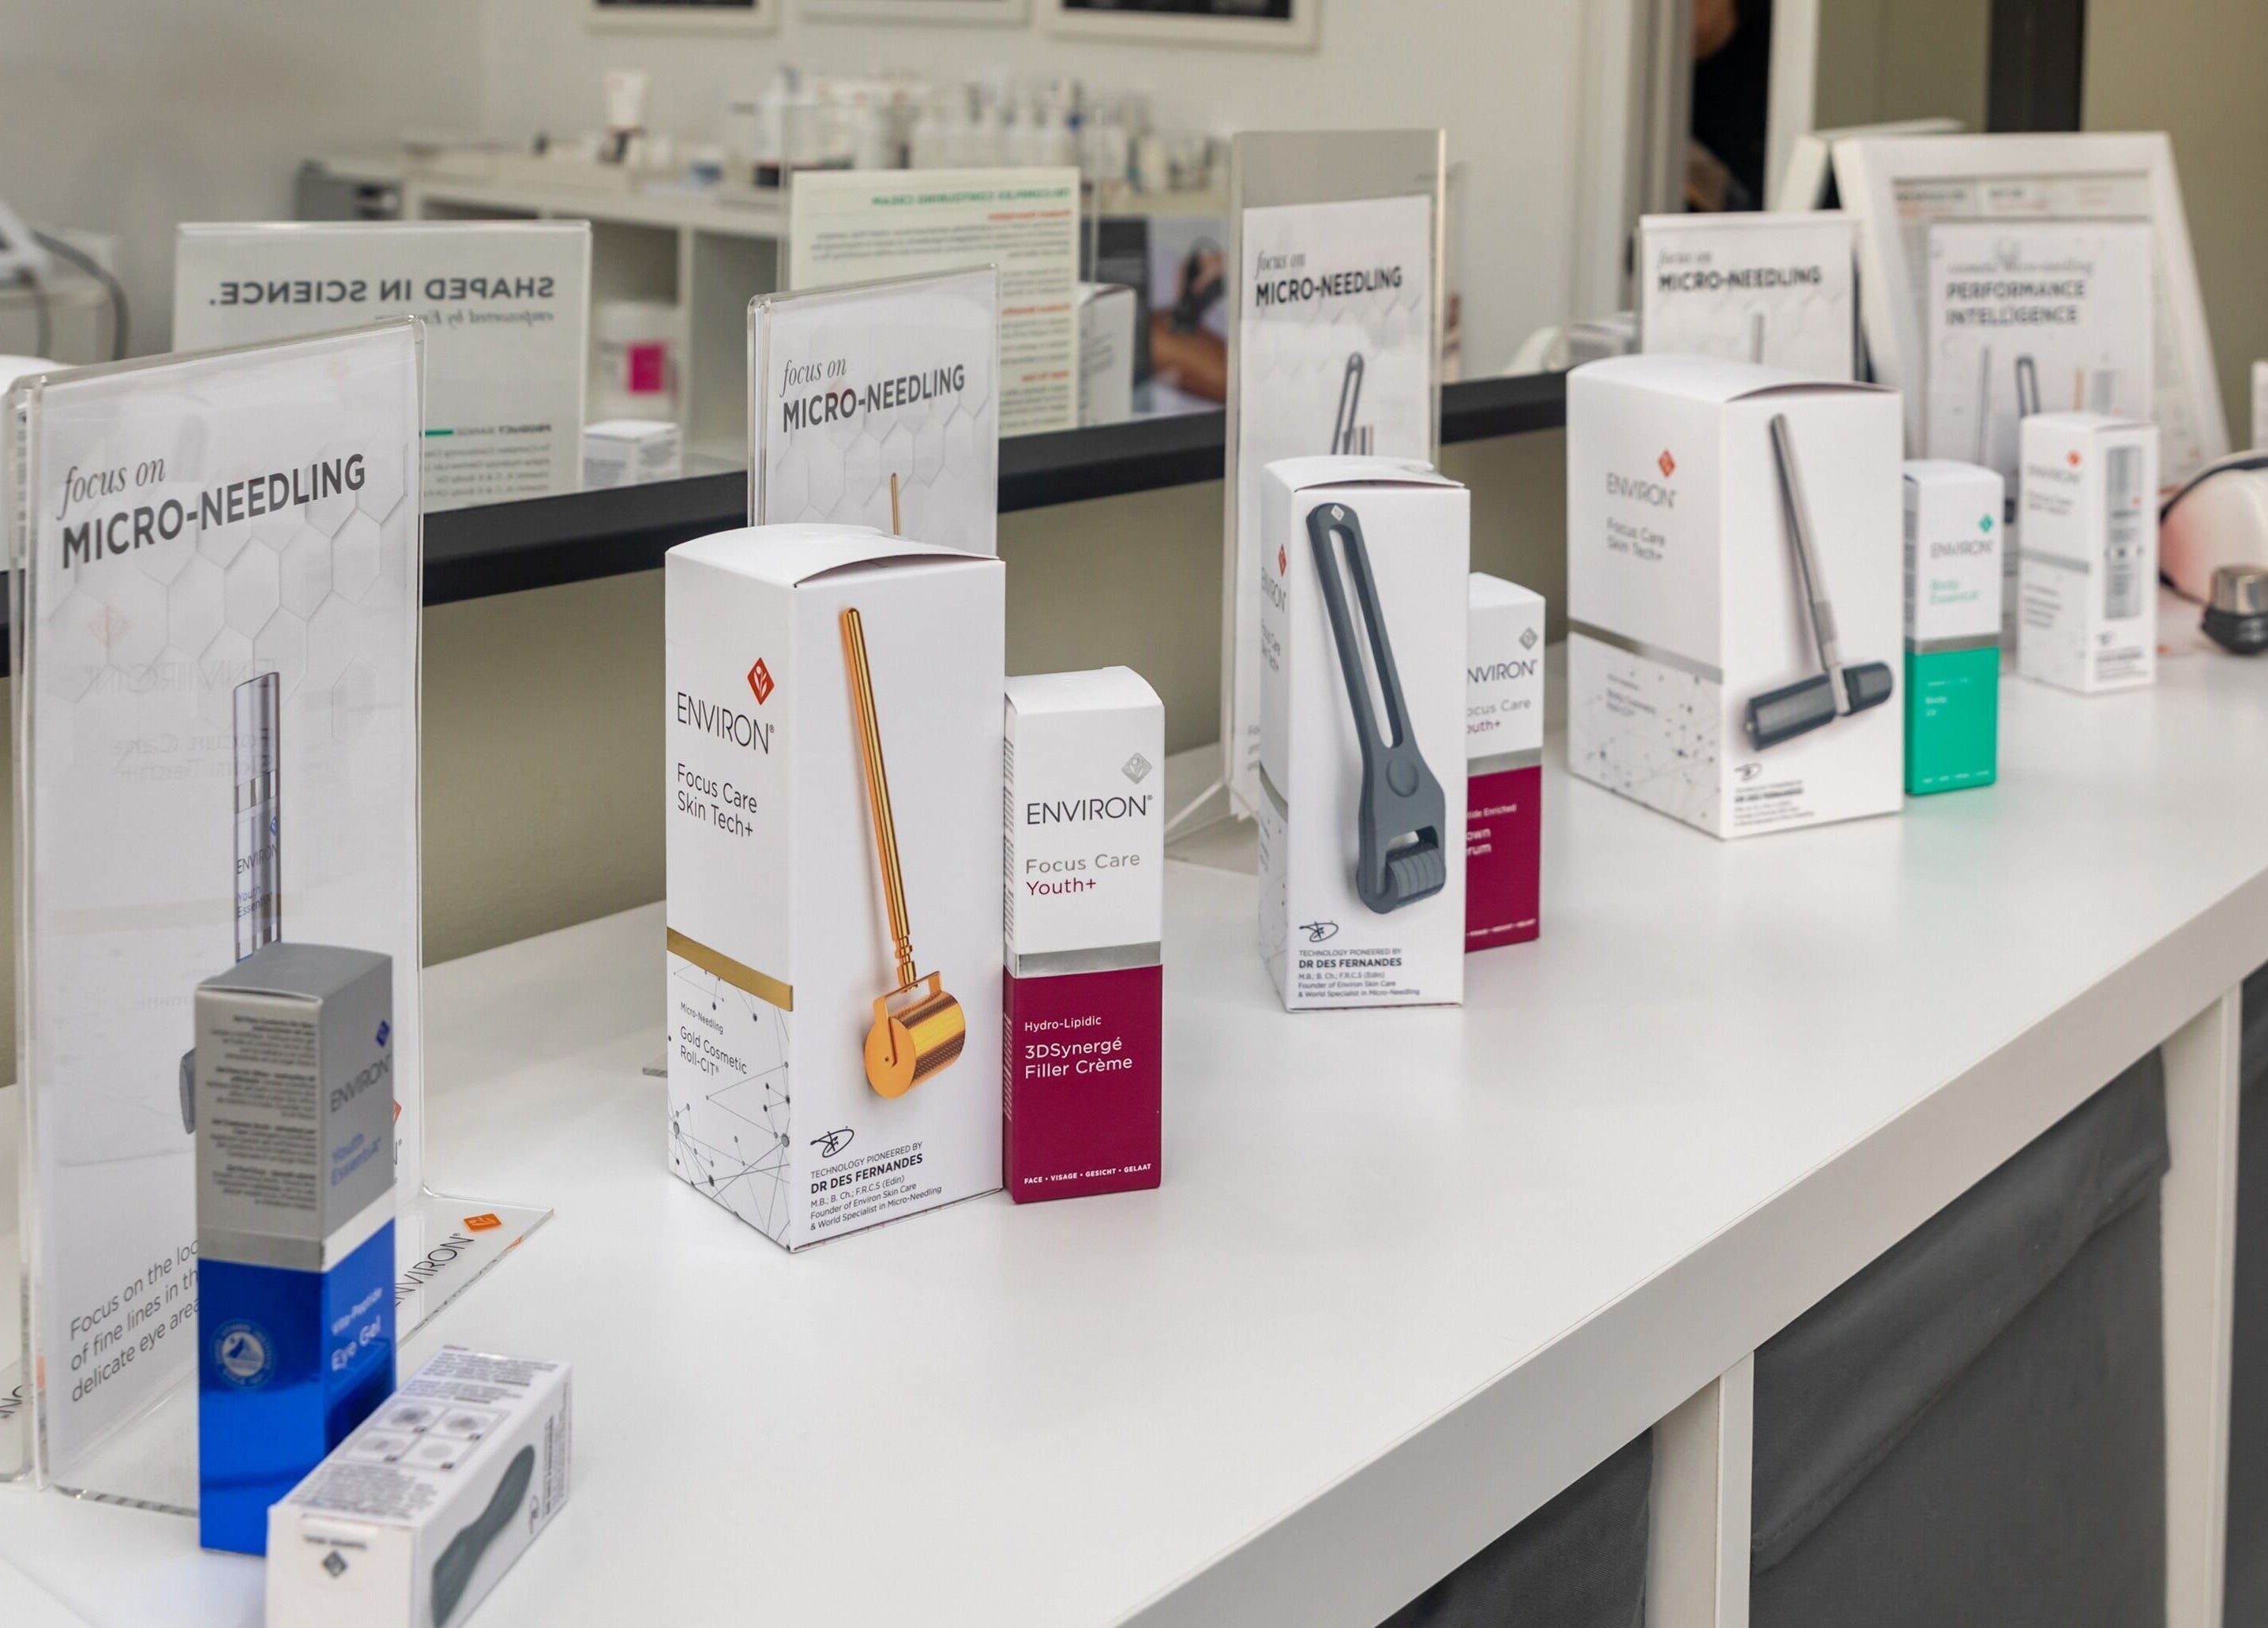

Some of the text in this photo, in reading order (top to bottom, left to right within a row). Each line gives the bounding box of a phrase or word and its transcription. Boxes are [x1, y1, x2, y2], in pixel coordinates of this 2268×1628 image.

[1255, 250, 1287, 280] focus
[1658, 265, 1822, 292] MICRO-NEEDLING
[1256, 266, 1402, 307] MICRO-NEEDLING
[1946, 280, 2086, 301] PERFORMANCE
[1946, 305, 2079, 326] INTELLIGENCE
[779, 358, 847, 397] focus on
[783, 363, 965, 433] MICRO-NEEDLING
[55, 457, 165, 521] focus on
[63, 453, 365, 569] MICRO-NEEDLING
[1467, 660, 1536, 684] NVIRON
[1467, 720, 1501, 734] outh+
[678, 763, 757, 814] Focus Care
[678, 791, 753, 837] Skin Tech+
[1026, 854, 1140, 874] Focus Care
[1026, 878, 1097, 896] Youth+
[1299, 957, 1402, 968] DR DES FERNANDES
[1327, 989, 1359, 998] Specialist
[681, 1002, 723, 1035] Micro-Needling
[1024, 1016, 1102, 1032] Hydro-Lipidic
[680, 1026, 747, 1074] Gold Cosmetic
[1025, 1036, 1122, 1059] 3DSynergé
[1025, 1058, 1132, 1079] Filler Crème
[810, 1141, 922, 1179] TECHNOLOGY PIONEERED BY
[811, 1153, 923, 1194] DR DES FERNANDES
[1024, 1164, 1151, 1185] FACE VISAGE GESICHT GELAAT
[810, 1182, 917, 1220] Founder of Environ Skin Care
[831, 1194, 838, 1202] B.
[855, 1182, 881, 1196] F.R.C.S
[882, 1175, 905, 1189] (Edin)
[817, 1214, 841, 1228] World
[842, 1205, 877, 1223] Specialist
[879, 1202, 886, 1211] in
[887, 1186, 942, 1208] Micro-Needling
[70, 1295, 119, 1340] Focus
[124, 1278, 144, 1303] on
[147, 1258, 172, 1285] the
[71, 1268, 197, 1371] of fine lines in th
[72, 1346, 136, 1402] delicate
[140, 1323, 166, 1352] eye
[332, 1341, 357, 1372] Eye
